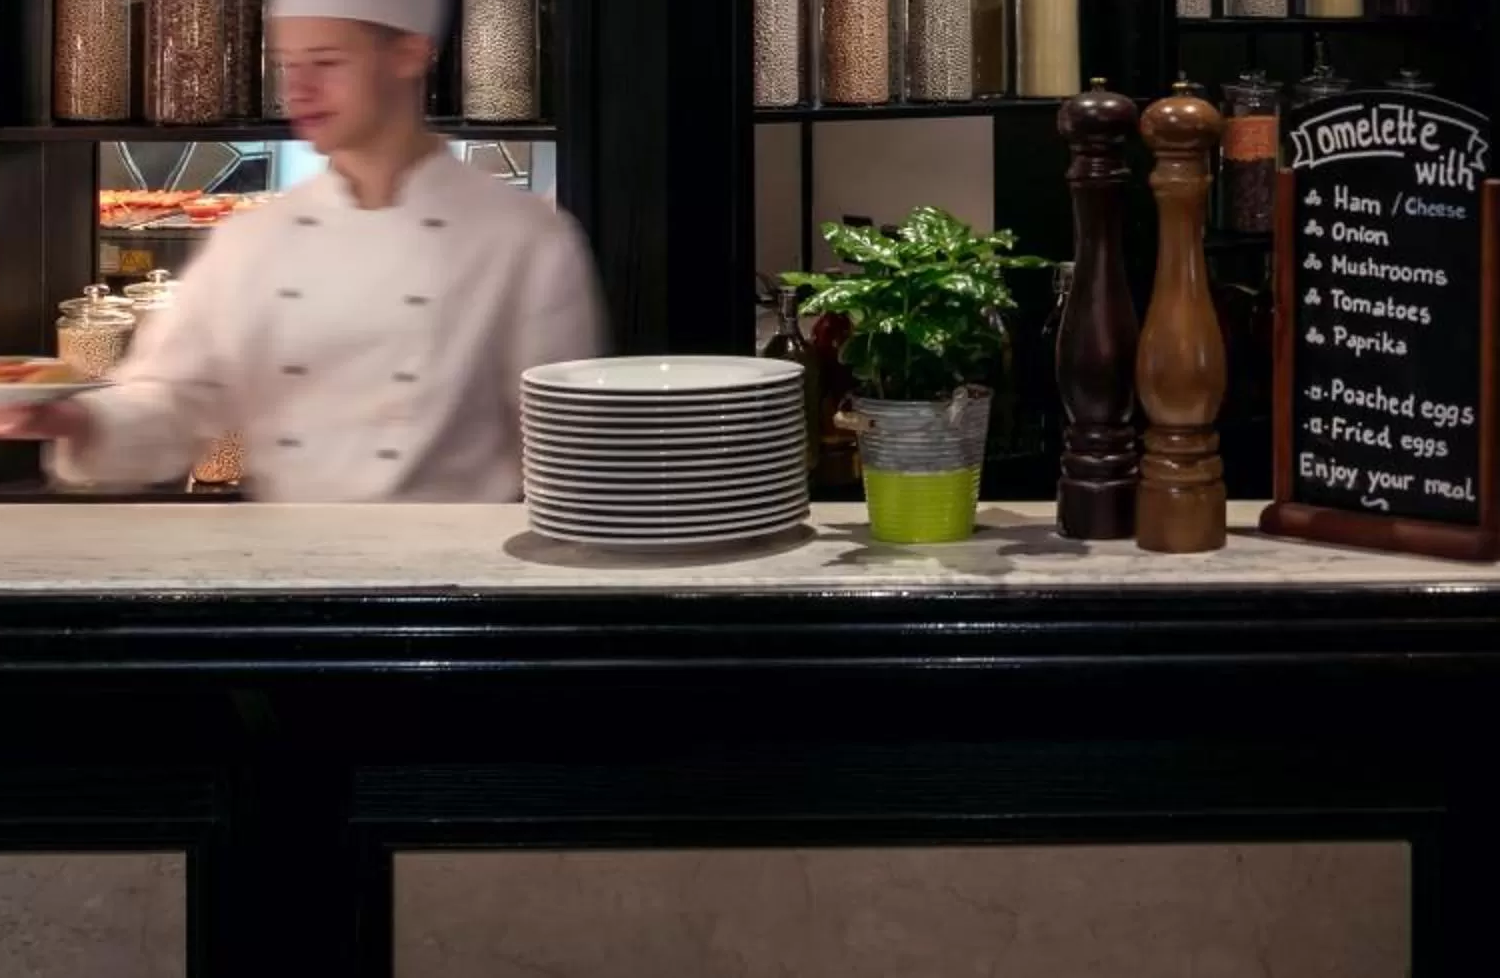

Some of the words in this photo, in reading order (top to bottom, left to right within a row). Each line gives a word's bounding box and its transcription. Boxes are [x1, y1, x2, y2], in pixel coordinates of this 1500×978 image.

[1316, 104, 1441, 155] omelette
[1415, 147, 1476, 191] with
[1334, 185, 1381, 215] Ham
[1331, 221, 1389, 246] Onion
[1330, 254, 1449, 286] Mushrooms
[1330, 288, 1432, 325] Tomatoes
[1332, 325, 1408, 357] Paprika
[1420, 399, 1475, 428] eggs
[1330, 416, 1393, 449] Fried
[1400, 433, 1449, 458] eggs
[1299, 452, 1359, 490] Enjoy
[1367, 469, 1415, 494] your
